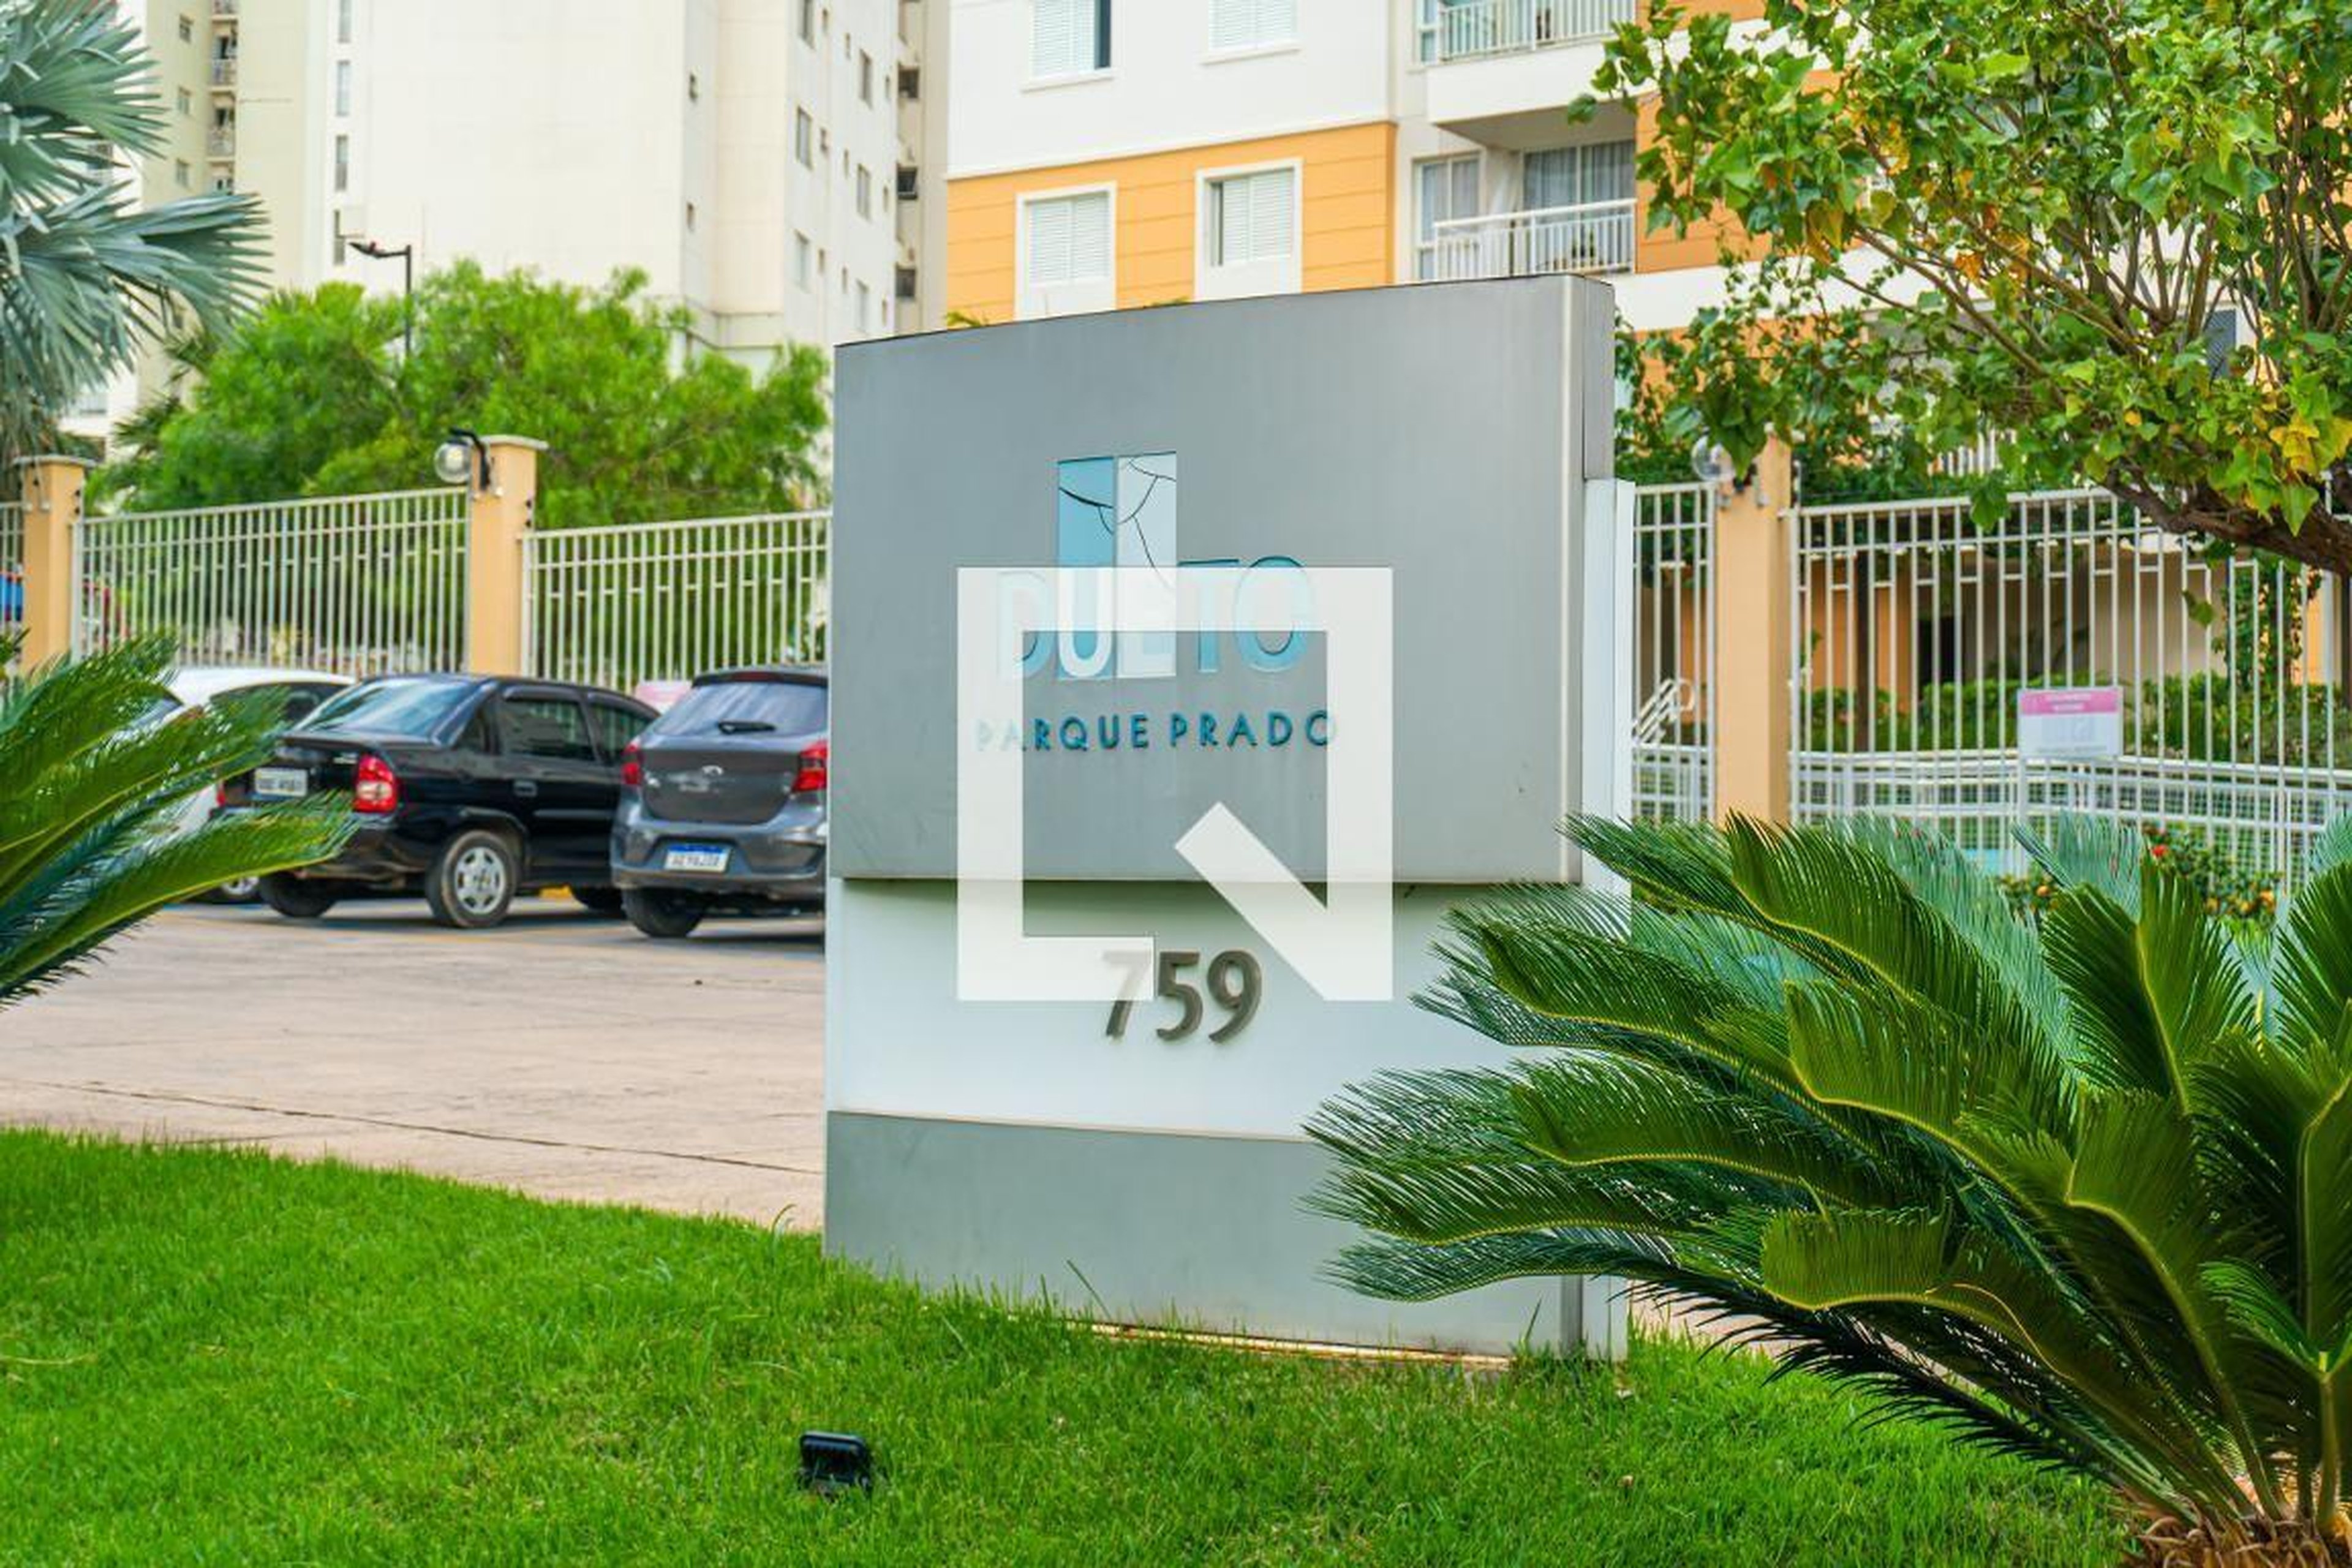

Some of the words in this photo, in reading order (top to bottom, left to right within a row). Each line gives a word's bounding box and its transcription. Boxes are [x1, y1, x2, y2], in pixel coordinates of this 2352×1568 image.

[975, 712, 1149, 752] PARQUE
[1169, 709, 1335, 747] PRADO
[1103, 949, 1262, 1043] 759
